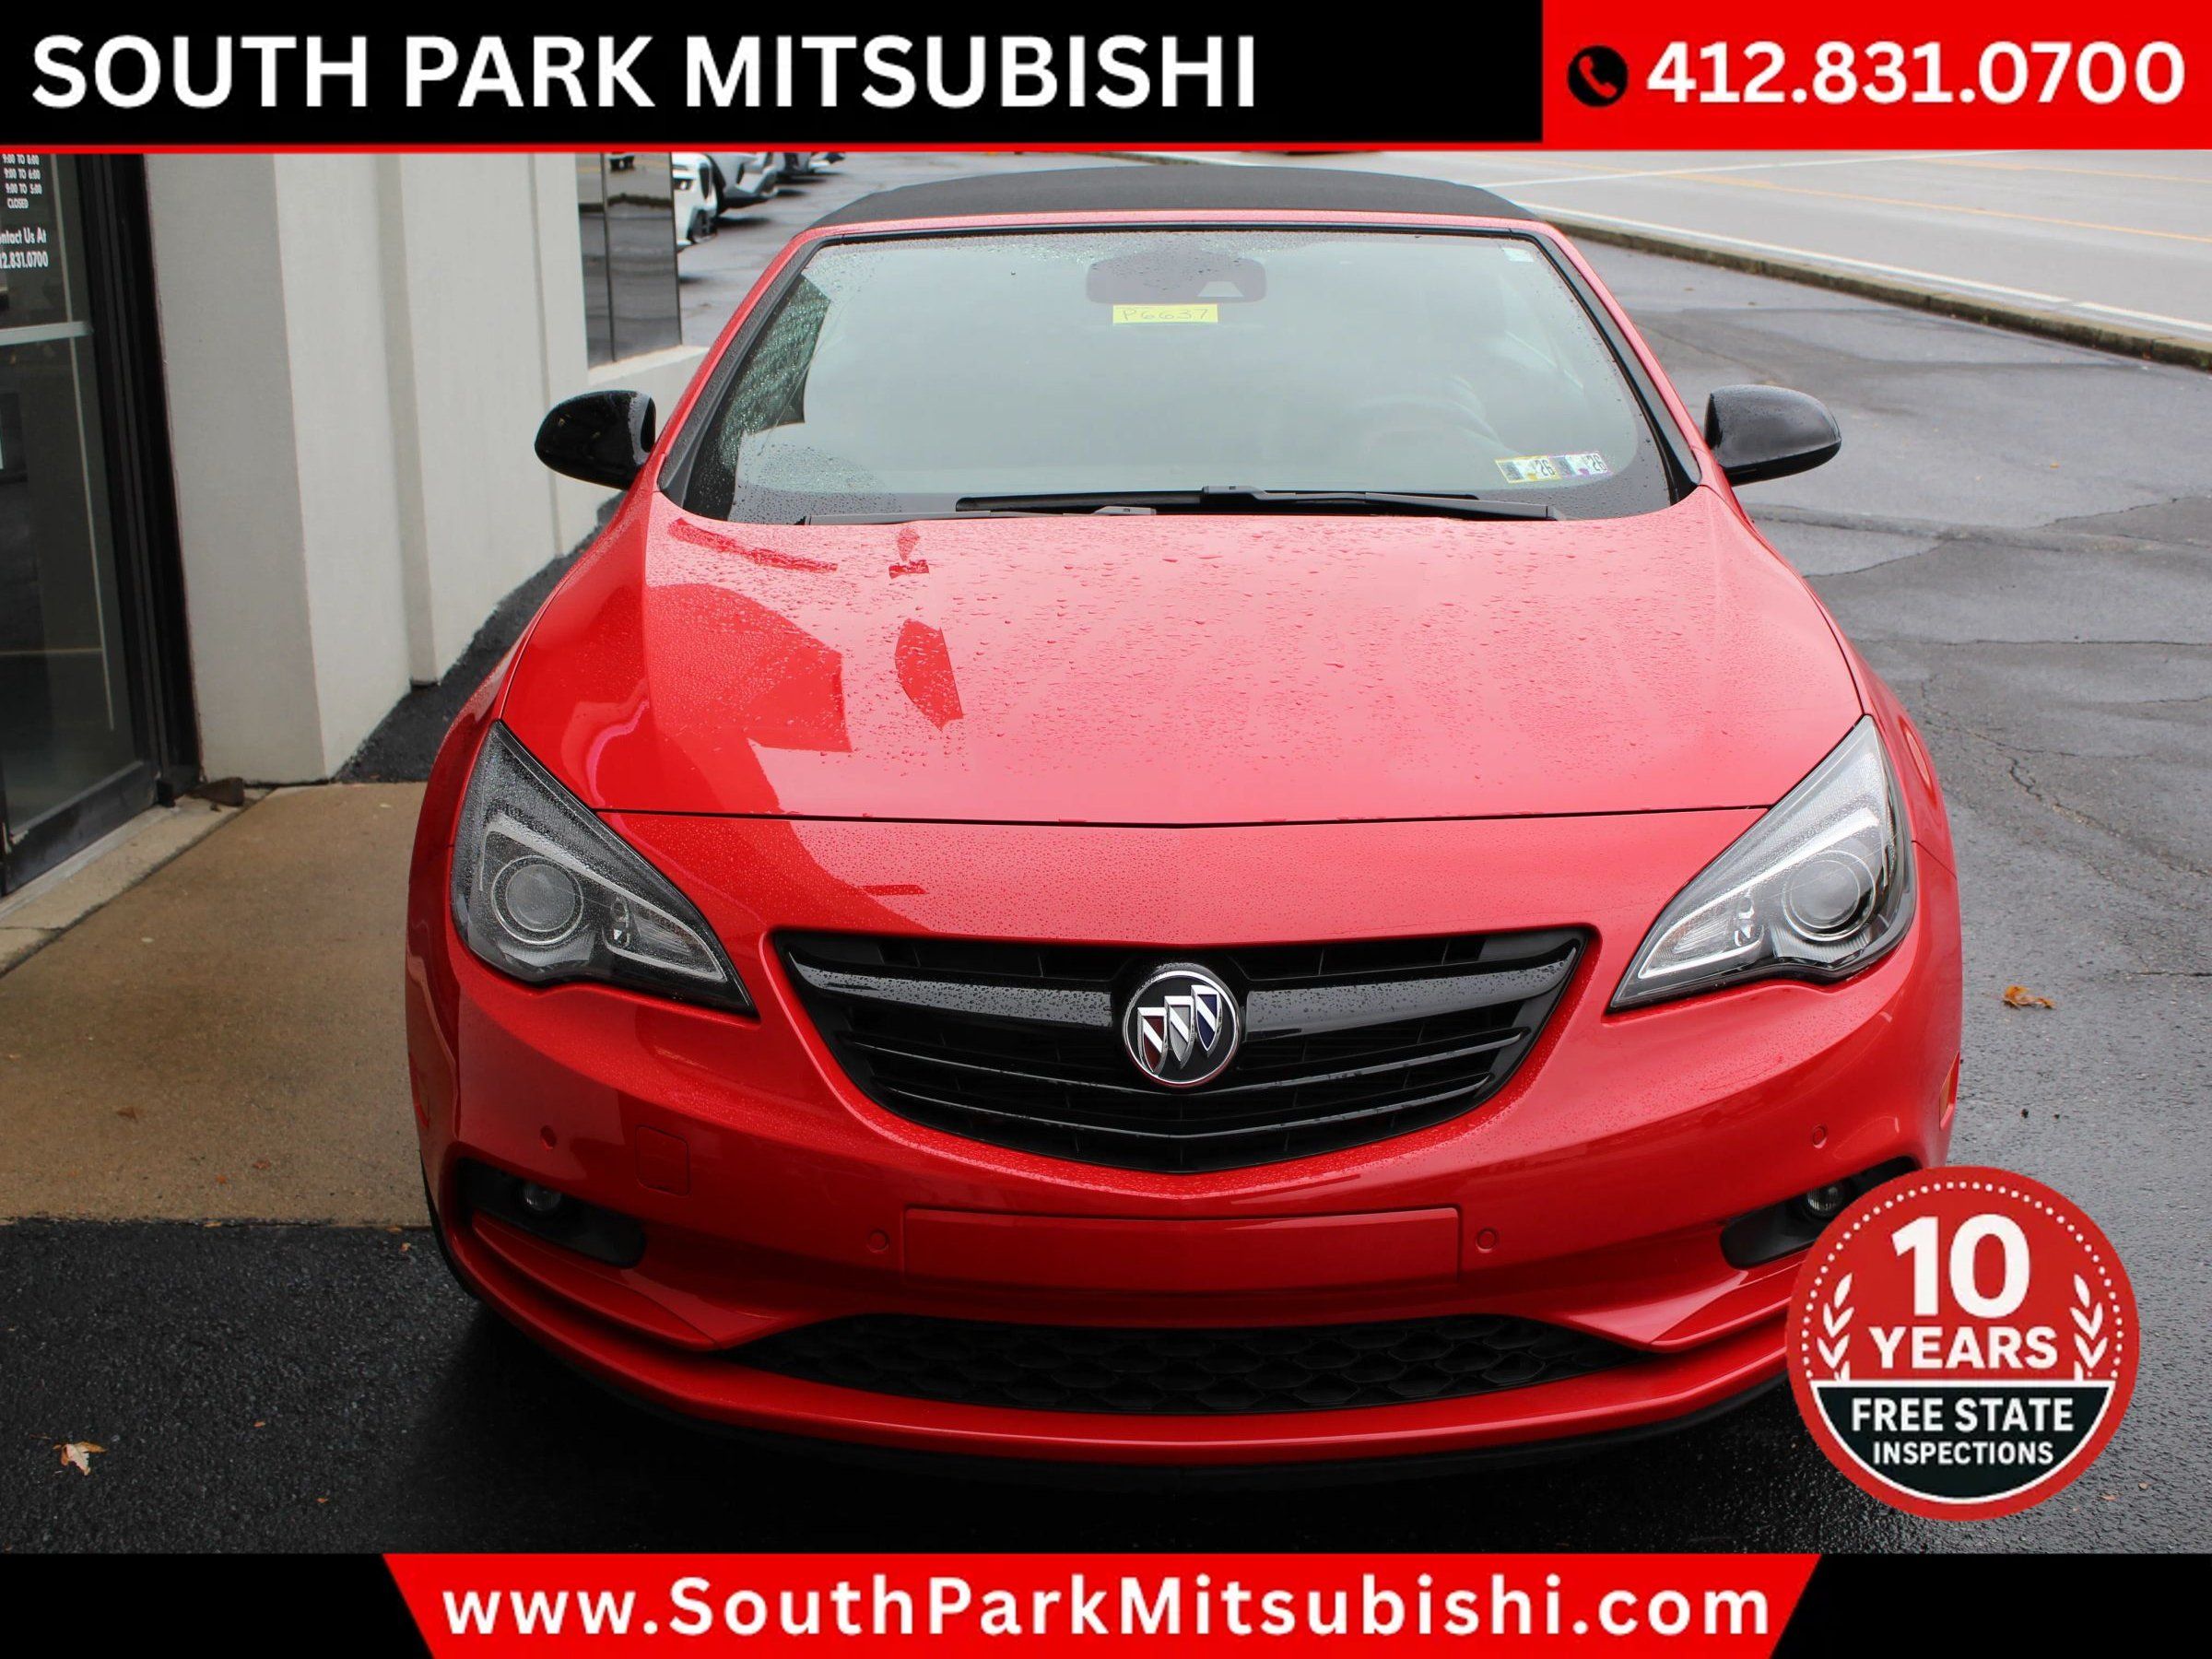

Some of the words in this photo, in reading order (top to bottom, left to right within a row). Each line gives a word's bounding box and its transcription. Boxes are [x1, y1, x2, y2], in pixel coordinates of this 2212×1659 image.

[7, 197, 29, 209] CLOSED
[23, 227, 35, 244] Us
[37, 227, 47, 243] At
